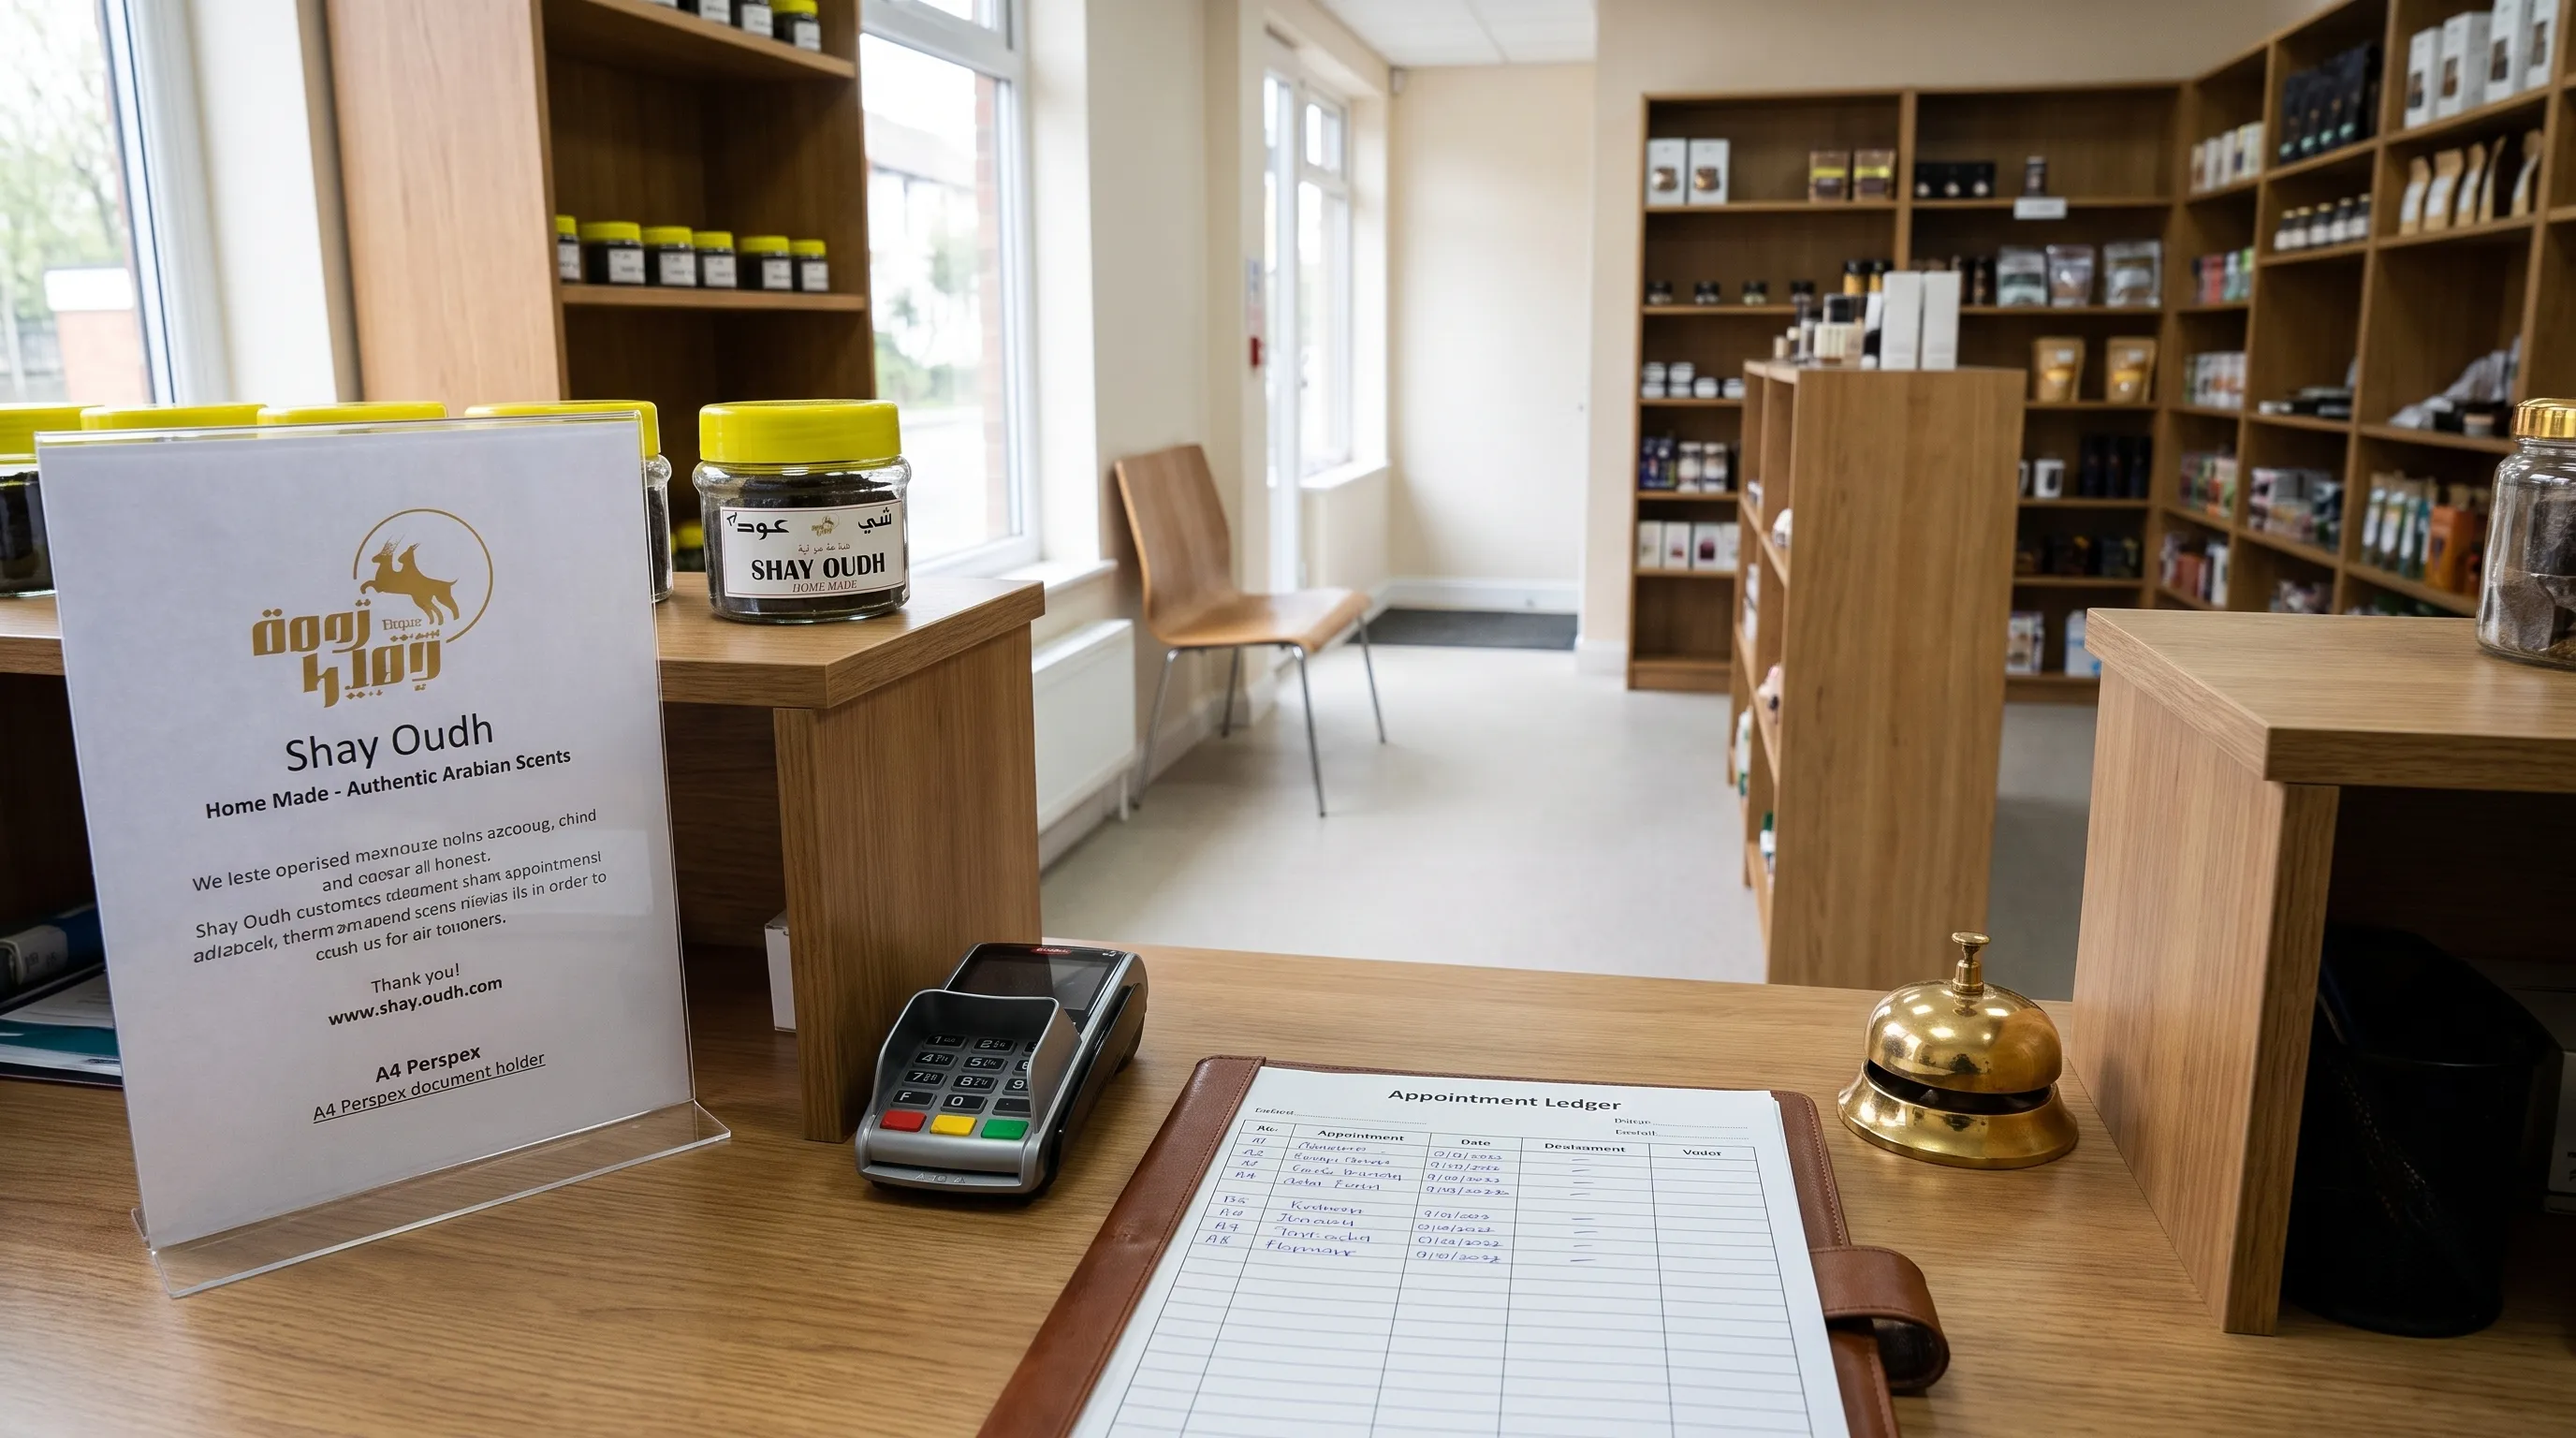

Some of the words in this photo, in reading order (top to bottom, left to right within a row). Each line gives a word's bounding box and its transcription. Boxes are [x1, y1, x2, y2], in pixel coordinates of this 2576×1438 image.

[752, 559, 814, 580] SHAY
[823, 552, 886, 579] OUDH
[792, 580, 826, 593] HOME
[827, 580, 857, 592] MADE
[285, 735, 379, 771] Shay
[392, 712, 493, 756] Oudh
[205, 798, 268, 819] Home
[272, 786, 329, 809] Made
[347, 770, 438, 799] Authentic
[442, 756, 511, 783] Arabian
[515, 748, 572, 772] Scents
[192, 874, 223, 891] We
[228, 868, 271, 887] leste
[559, 809, 597, 828] chind
[322, 873, 353, 892] and
[415, 858, 431, 875] all
[435, 851, 491, 872] honest.
[415, 902, 457, 919] scens
[533, 883, 545, 896] in
[549, 874, 588, 893] order
[592, 872, 607, 886] to
[196, 920, 238, 939] Shay
[243, 908, 291, 930] Oudh
[363, 937, 382, 951] us
[387, 931, 408, 946] for
[413, 926, 432, 942] air
[371, 972, 422, 994] Thank
[424, 962, 461, 986] you!
[328, 976, 503, 1026] www.shay.oudh.com
[934, 1035, 942, 1044] 1
[980, 1040, 992, 1049] 2
[375, 1063, 402, 1083] A4
[407, 1046, 481, 1077] Perspex
[922, 1053, 934, 1062] 4
[970, 1058, 983, 1066] 5
[313, 1103, 336, 1122] A4
[341, 1087, 407, 1113] Perspex
[411, 1065, 491, 1096] document
[495, 1053, 546, 1075] holder
[913, 1072, 924, 1080] 7
[960, 1077, 973, 1086] 8
[1012, 1079, 1024, 1089] 9
[900, 1092, 912, 1101] F
[1388, 1090, 1538, 1107] Appointment
[1544, 1097, 1621, 1111] Ledger
[1318, 1129, 1404, 1142] Appointment
